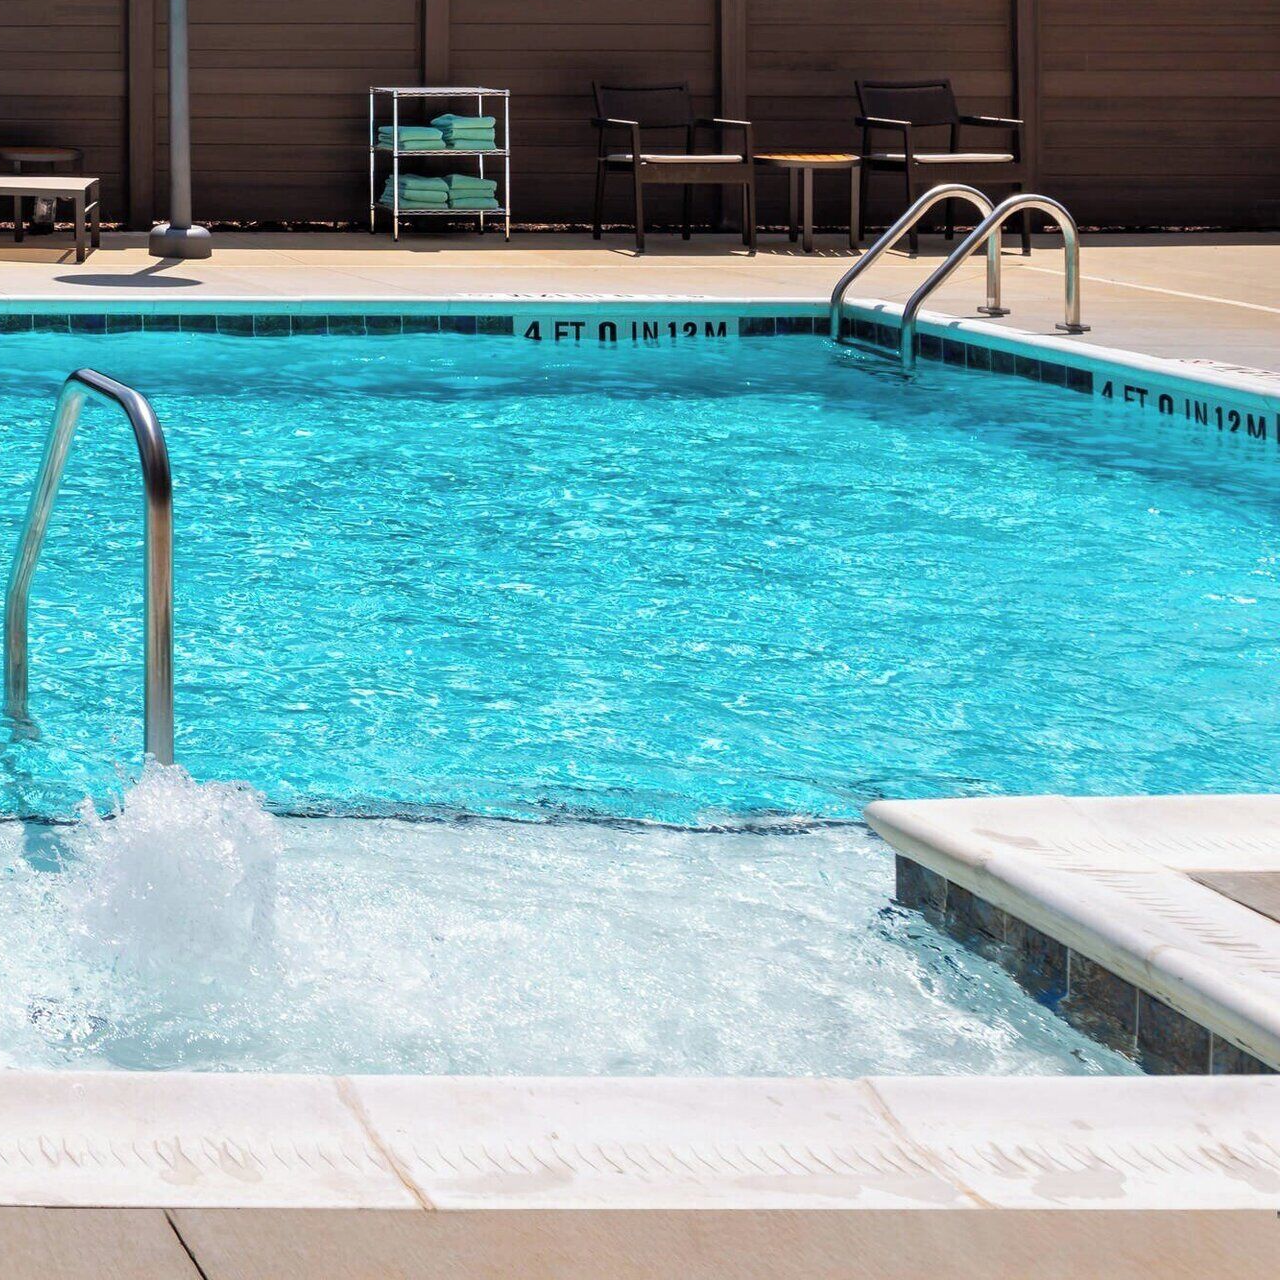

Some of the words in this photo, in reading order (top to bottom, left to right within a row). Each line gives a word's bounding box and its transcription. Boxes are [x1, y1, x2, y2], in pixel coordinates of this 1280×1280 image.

[524, 321, 542, 341] 4
[554, 321, 586, 341] FT
[632, 321, 658, 341] IN
[1101, 380, 1113, 399] 4
[1124, 384, 1149, 408] FT
[1185, 398, 1208, 426] IN
